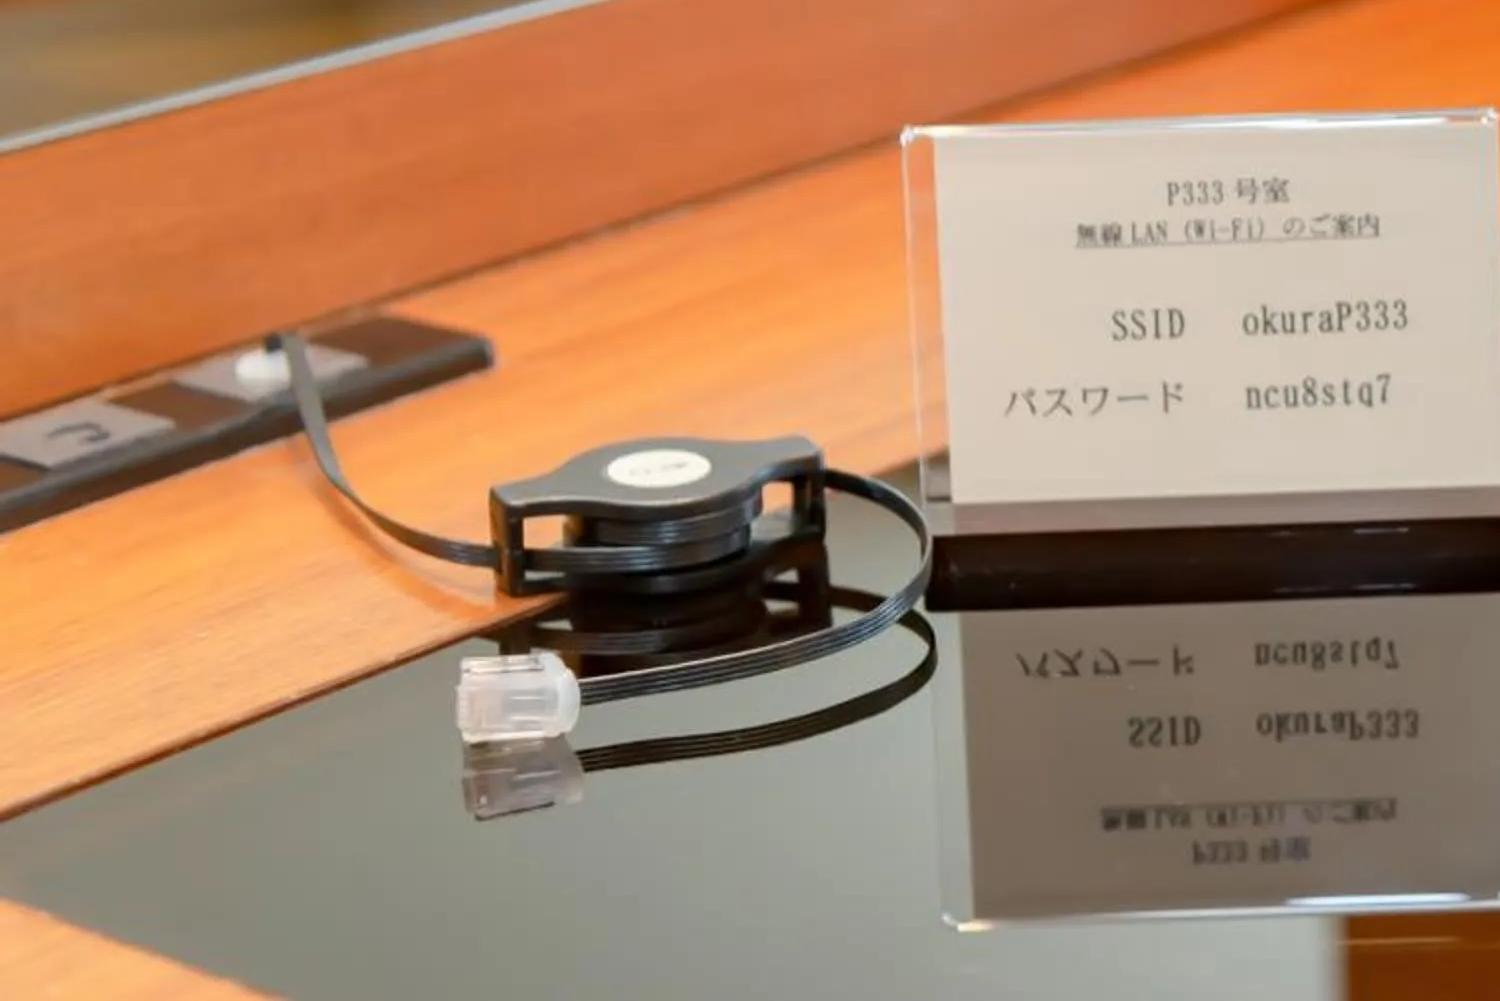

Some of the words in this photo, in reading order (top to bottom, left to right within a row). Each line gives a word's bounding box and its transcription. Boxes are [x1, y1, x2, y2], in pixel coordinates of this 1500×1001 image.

[1166, 179, 1225, 207] P333
[1111, 308, 1186, 342] SSID
[1242, 298, 1409, 337] okuraP333
[1004, 379, 1185, 417] パスワード
[1245, 372, 1392, 410] ncu8stq7
